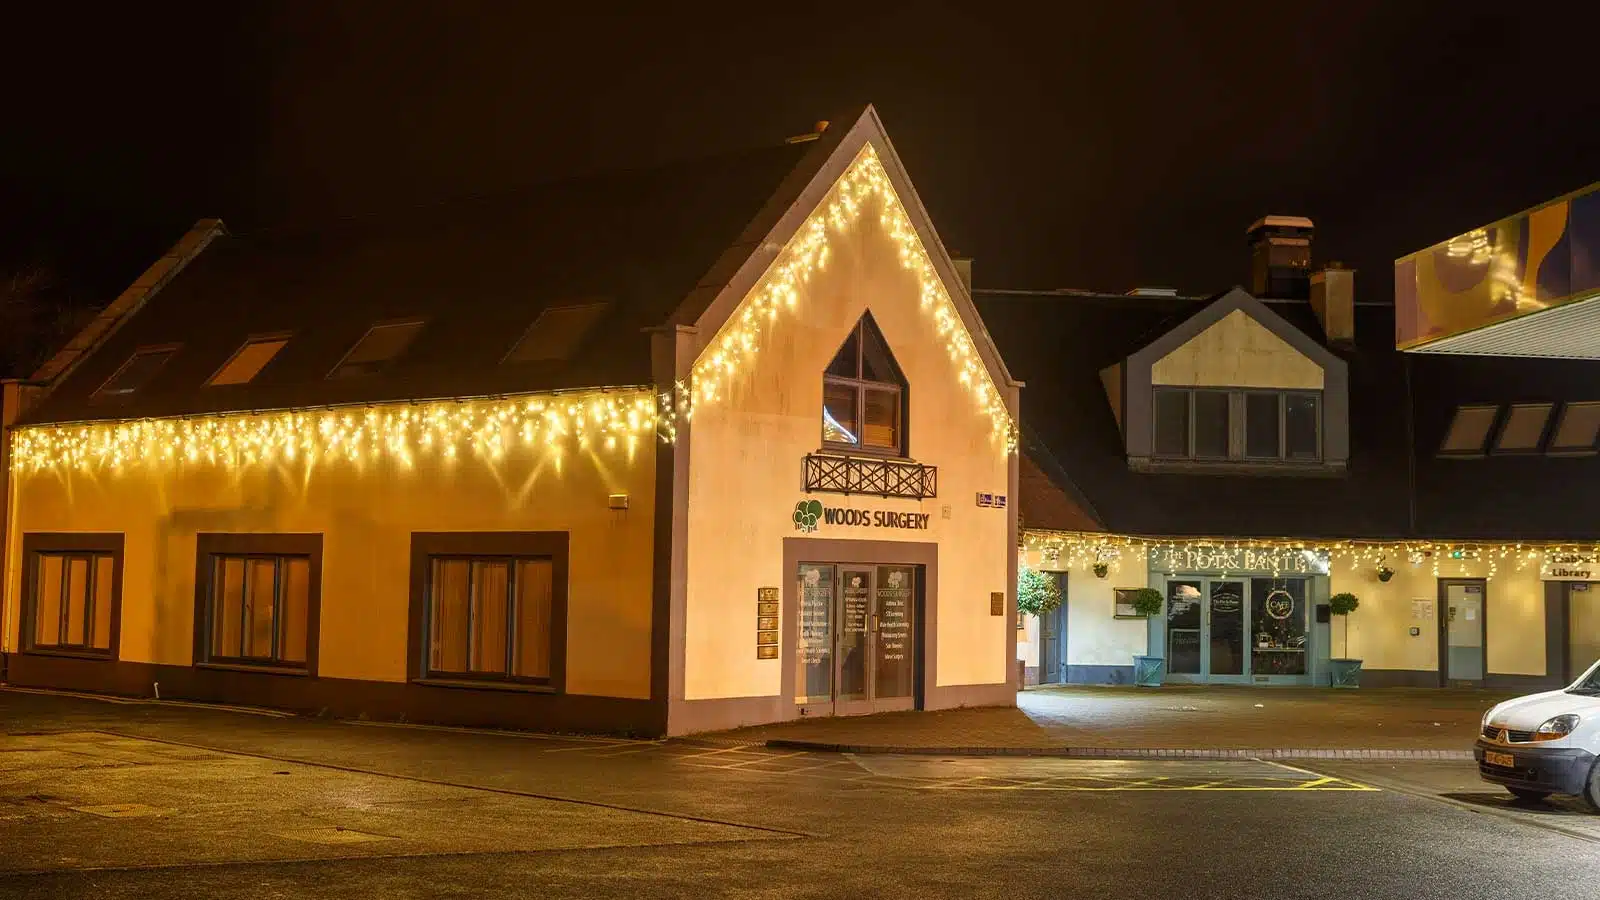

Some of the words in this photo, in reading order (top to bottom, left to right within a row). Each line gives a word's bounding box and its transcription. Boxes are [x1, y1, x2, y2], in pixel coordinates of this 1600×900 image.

[824, 508, 871, 527] WOODS
[873, 510, 930, 530] SURGERY
[1186, 551, 1222, 569] POT
[1226, 555, 1240, 569] &
[1552, 568, 1591, 579] Library
